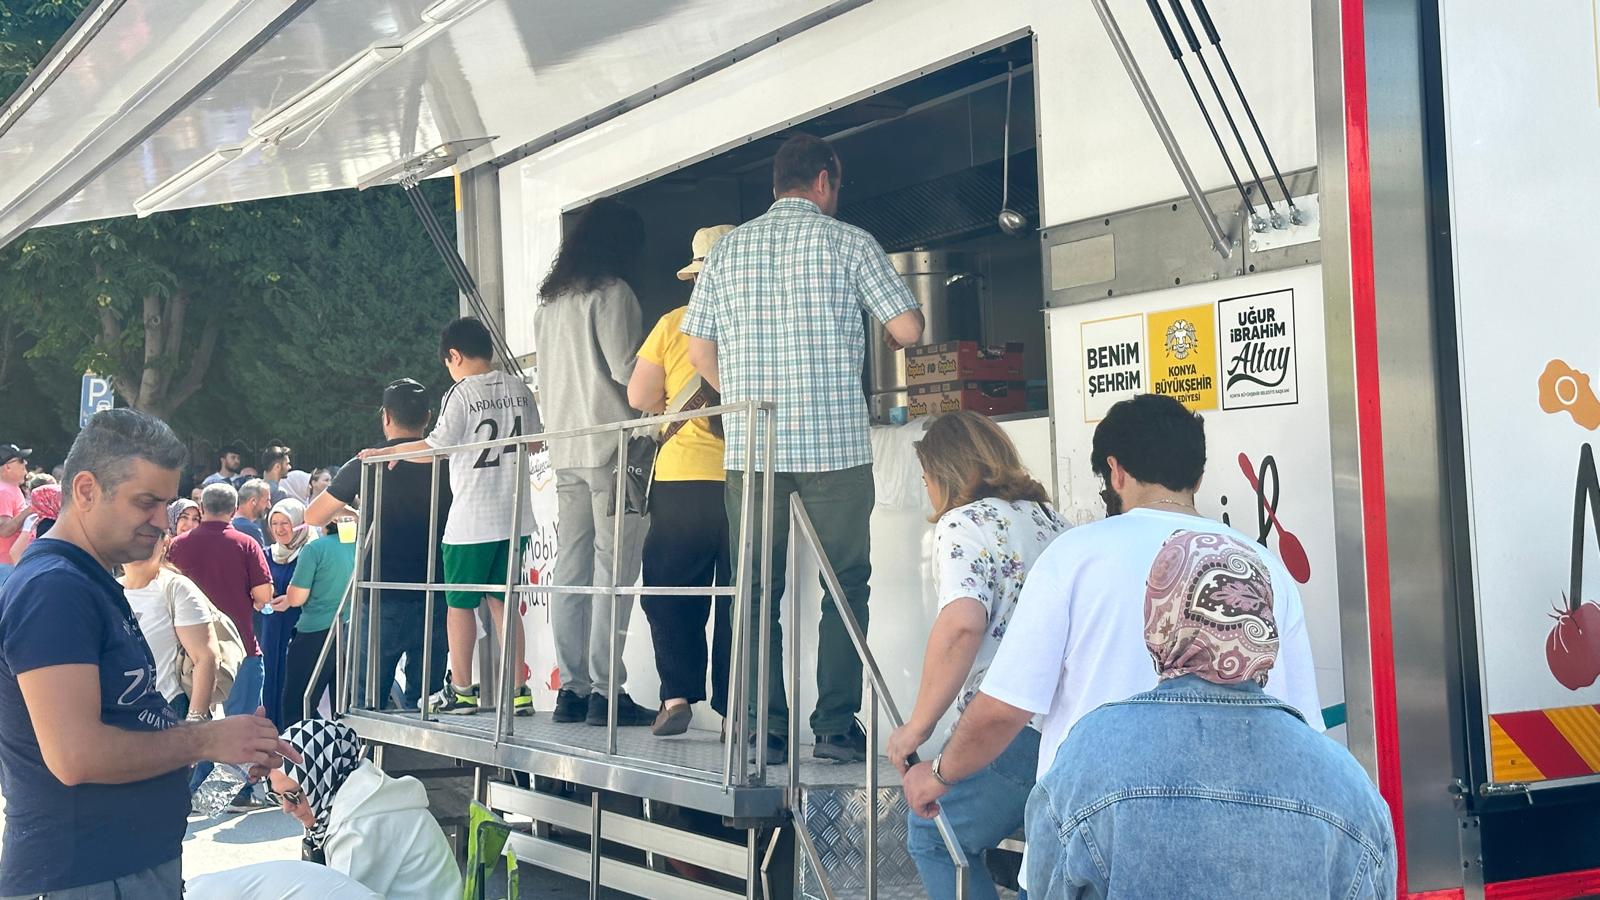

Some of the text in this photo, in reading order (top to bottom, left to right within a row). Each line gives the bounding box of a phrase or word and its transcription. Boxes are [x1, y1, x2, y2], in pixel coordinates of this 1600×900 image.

[1238, 306, 1276, 327] UĞUR
[1168, 364, 1197, 377] KONYA
[1226, 342, 1291, 391] Altay
[88, 378, 108, 408] P
[1155, 374, 1212, 394] BÜYÜKŞEHİR
[469, 396, 529, 415] ARDAGÜLER
[473, 415, 525, 469] 24
